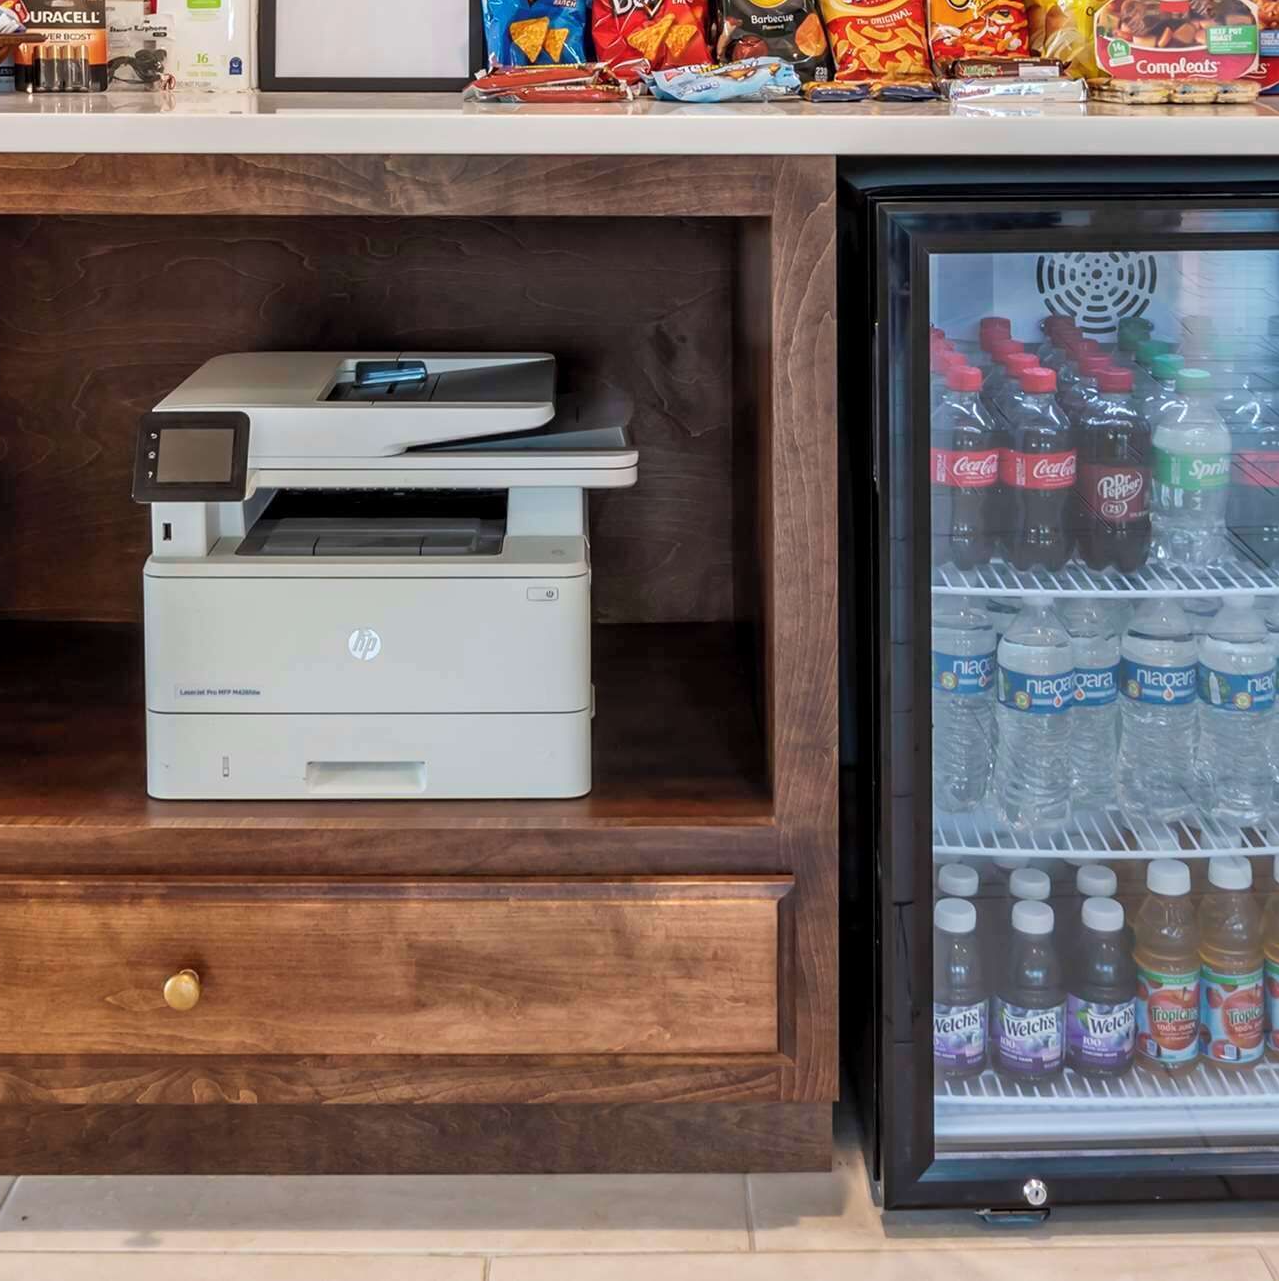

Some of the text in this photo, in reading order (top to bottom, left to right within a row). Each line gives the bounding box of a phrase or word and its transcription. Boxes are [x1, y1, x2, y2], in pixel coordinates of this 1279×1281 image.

[751, 14, 794, 25] Barbecue
[870, 8, 913, 25] ORIGINAL
[196, 53, 209, 64] 16
[1135, 57, 1218, 77] Compleats
[1188, 458, 1230, 480] Spri
[1103, 477, 1141, 500] Pepper
[1115, 474, 1132, 485] Dr
[349, 628, 381, 661] hp
[952, 656, 992, 679] niag
[1136, 667, 1197, 688] niagara
[1025, 676, 1073, 697] niaga
[1074, 670, 1113, 689] gara
[1228, 1006, 1264, 1024] Tropic
[1006, 1014, 1056, 1037] Welch's
